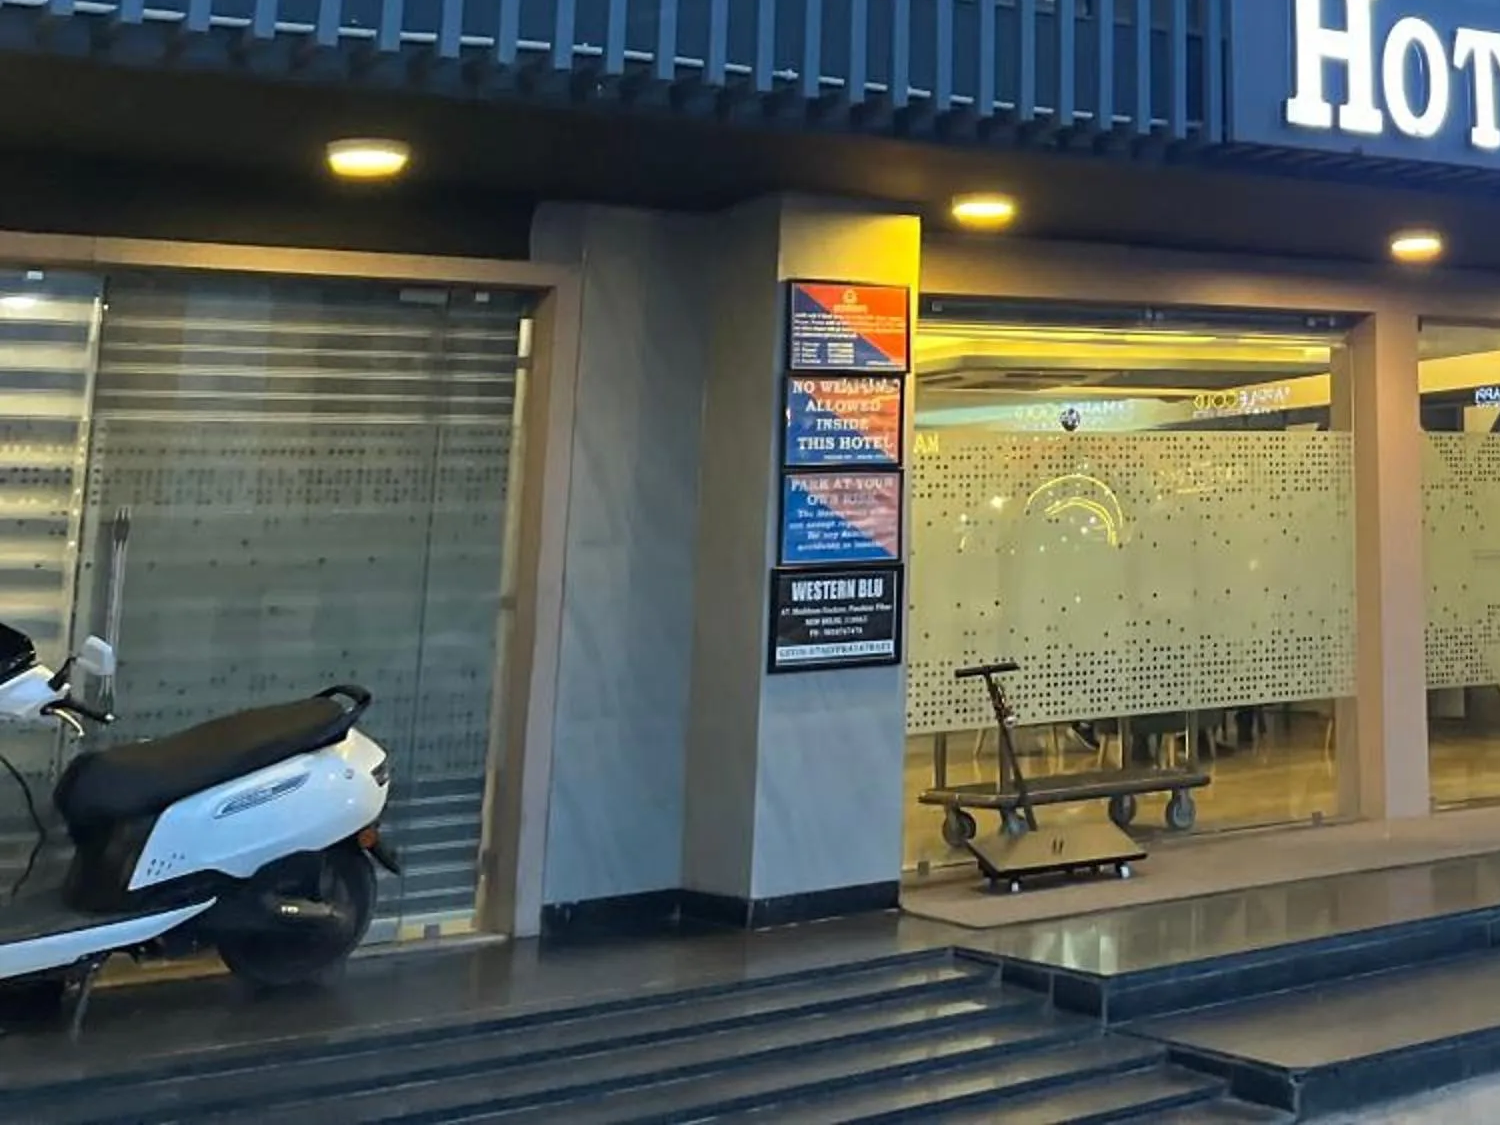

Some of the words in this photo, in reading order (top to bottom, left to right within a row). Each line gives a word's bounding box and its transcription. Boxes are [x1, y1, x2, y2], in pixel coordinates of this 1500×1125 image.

[792, 380, 815, 394] NO
[805, 398, 881, 413] ALLOWED
[816, 417, 869, 431] INSIDE
[796, 436, 835, 451] THIS
[839, 432, 895, 451] HOTEL
[791, 477, 829, 492] PARK
[833, 477, 853, 490] AT
[855, 476, 894, 490] YOUR
[791, 579, 856, 602] WESTERN
[858, 578, 884, 598] BLU
